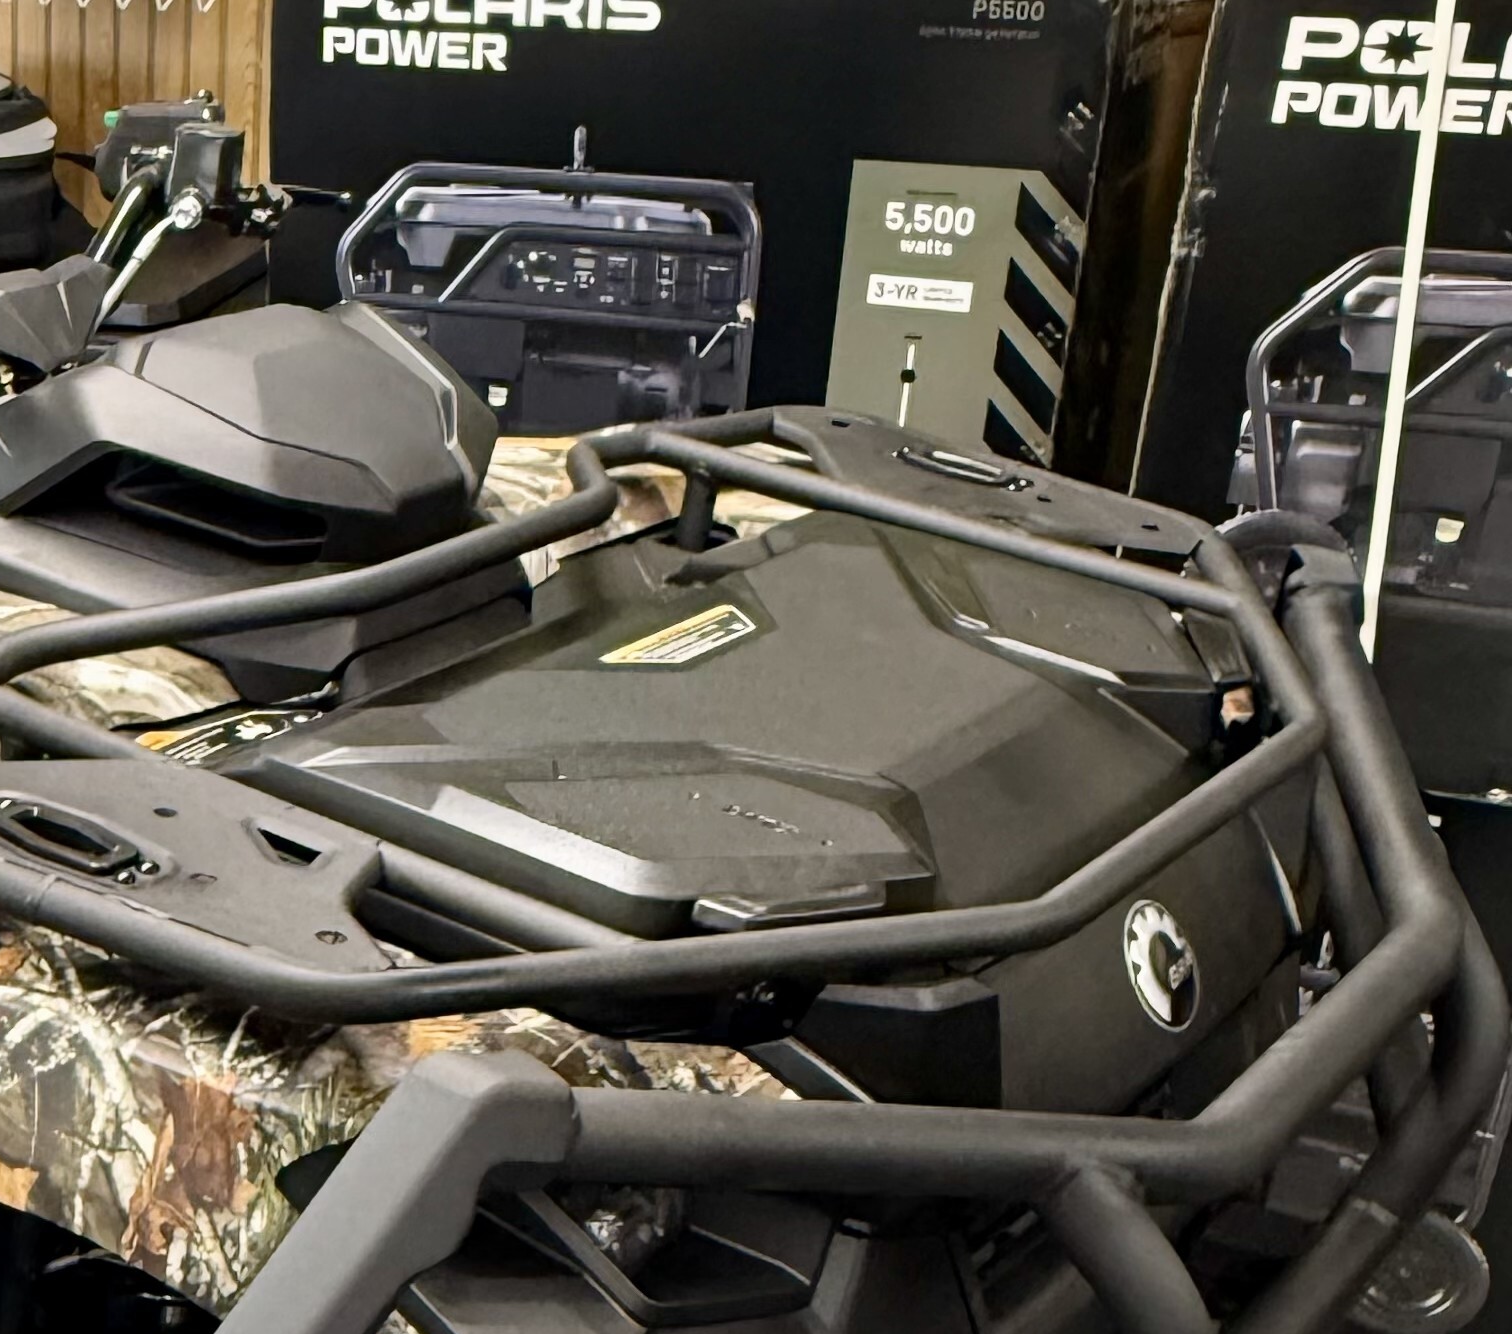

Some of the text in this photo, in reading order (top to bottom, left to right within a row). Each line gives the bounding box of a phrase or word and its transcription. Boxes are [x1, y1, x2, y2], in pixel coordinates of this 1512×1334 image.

[322, 26, 507, 71] POWER
[1281, 16, 1512, 81] POL
[885, 201, 976, 237] 5,500
